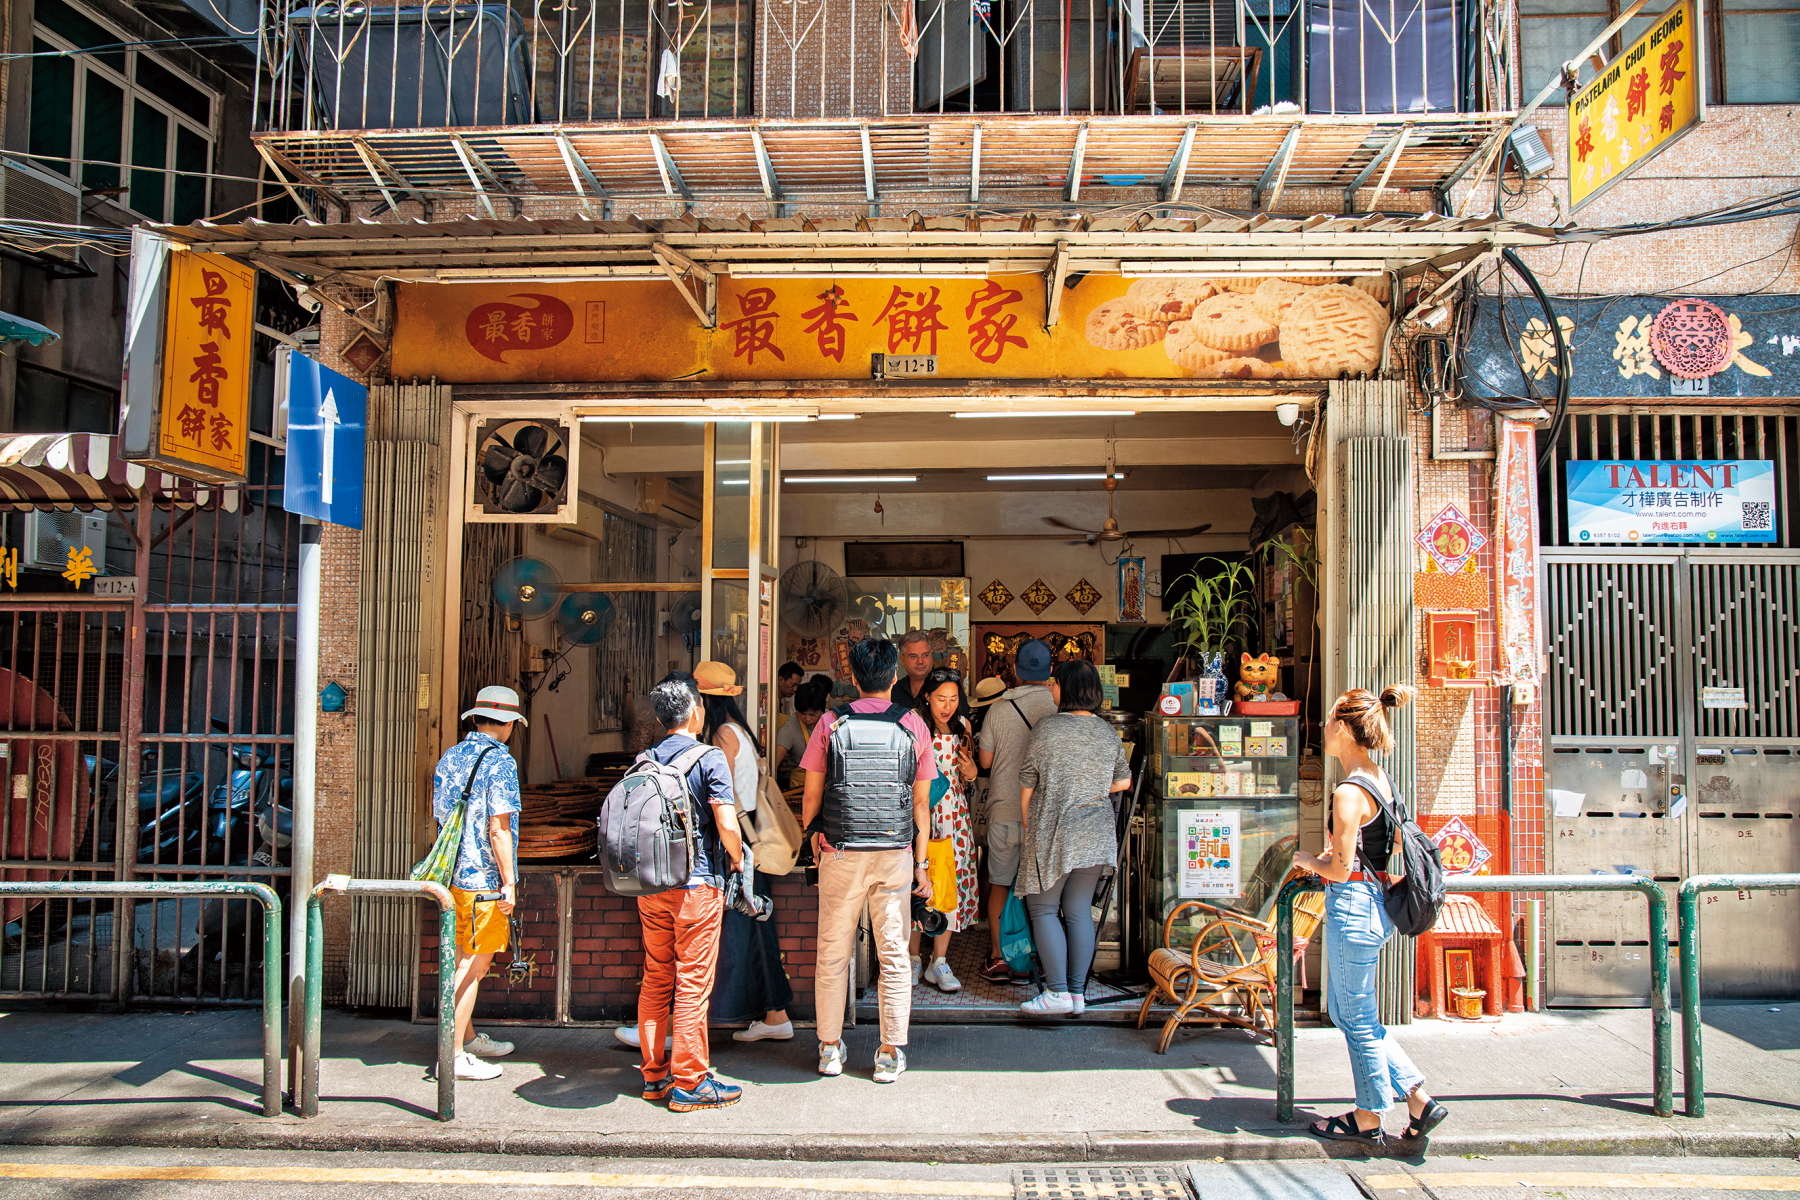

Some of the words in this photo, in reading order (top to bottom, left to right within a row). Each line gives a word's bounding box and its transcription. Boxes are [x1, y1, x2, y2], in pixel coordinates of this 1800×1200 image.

[1575, 68, 1621, 116] PASTELARIA
[1625, 42, 1646, 72] CHUI
[1650, 9, 1683, 50] HEONG
[1575, 40, 1686, 163] 最香餅家
[479, 310, 537, 343] 最香
[541, 313, 554, 340] 餅家
[720, 280, 1028, 364] 最香餅家
[190, 267, 231, 408] 最香
[904, 358, 934, 373] 12-B
[1692, 378, 1703, 391] 12
[177, 403, 233, 451] 餅家
[1604, 464, 1738, 488] TALENT
[1621, 491, 1723, 508] 才樺廣告制作
[1434, 522, 1466, 556] 福
[110, 581, 136, 593] 12-A
[986, 584, 1005, 604] 福
[1029, 584, 1048, 604] 福
[1072, 584, 1092, 604] 福
[1441, 835, 1470, 869] 福
